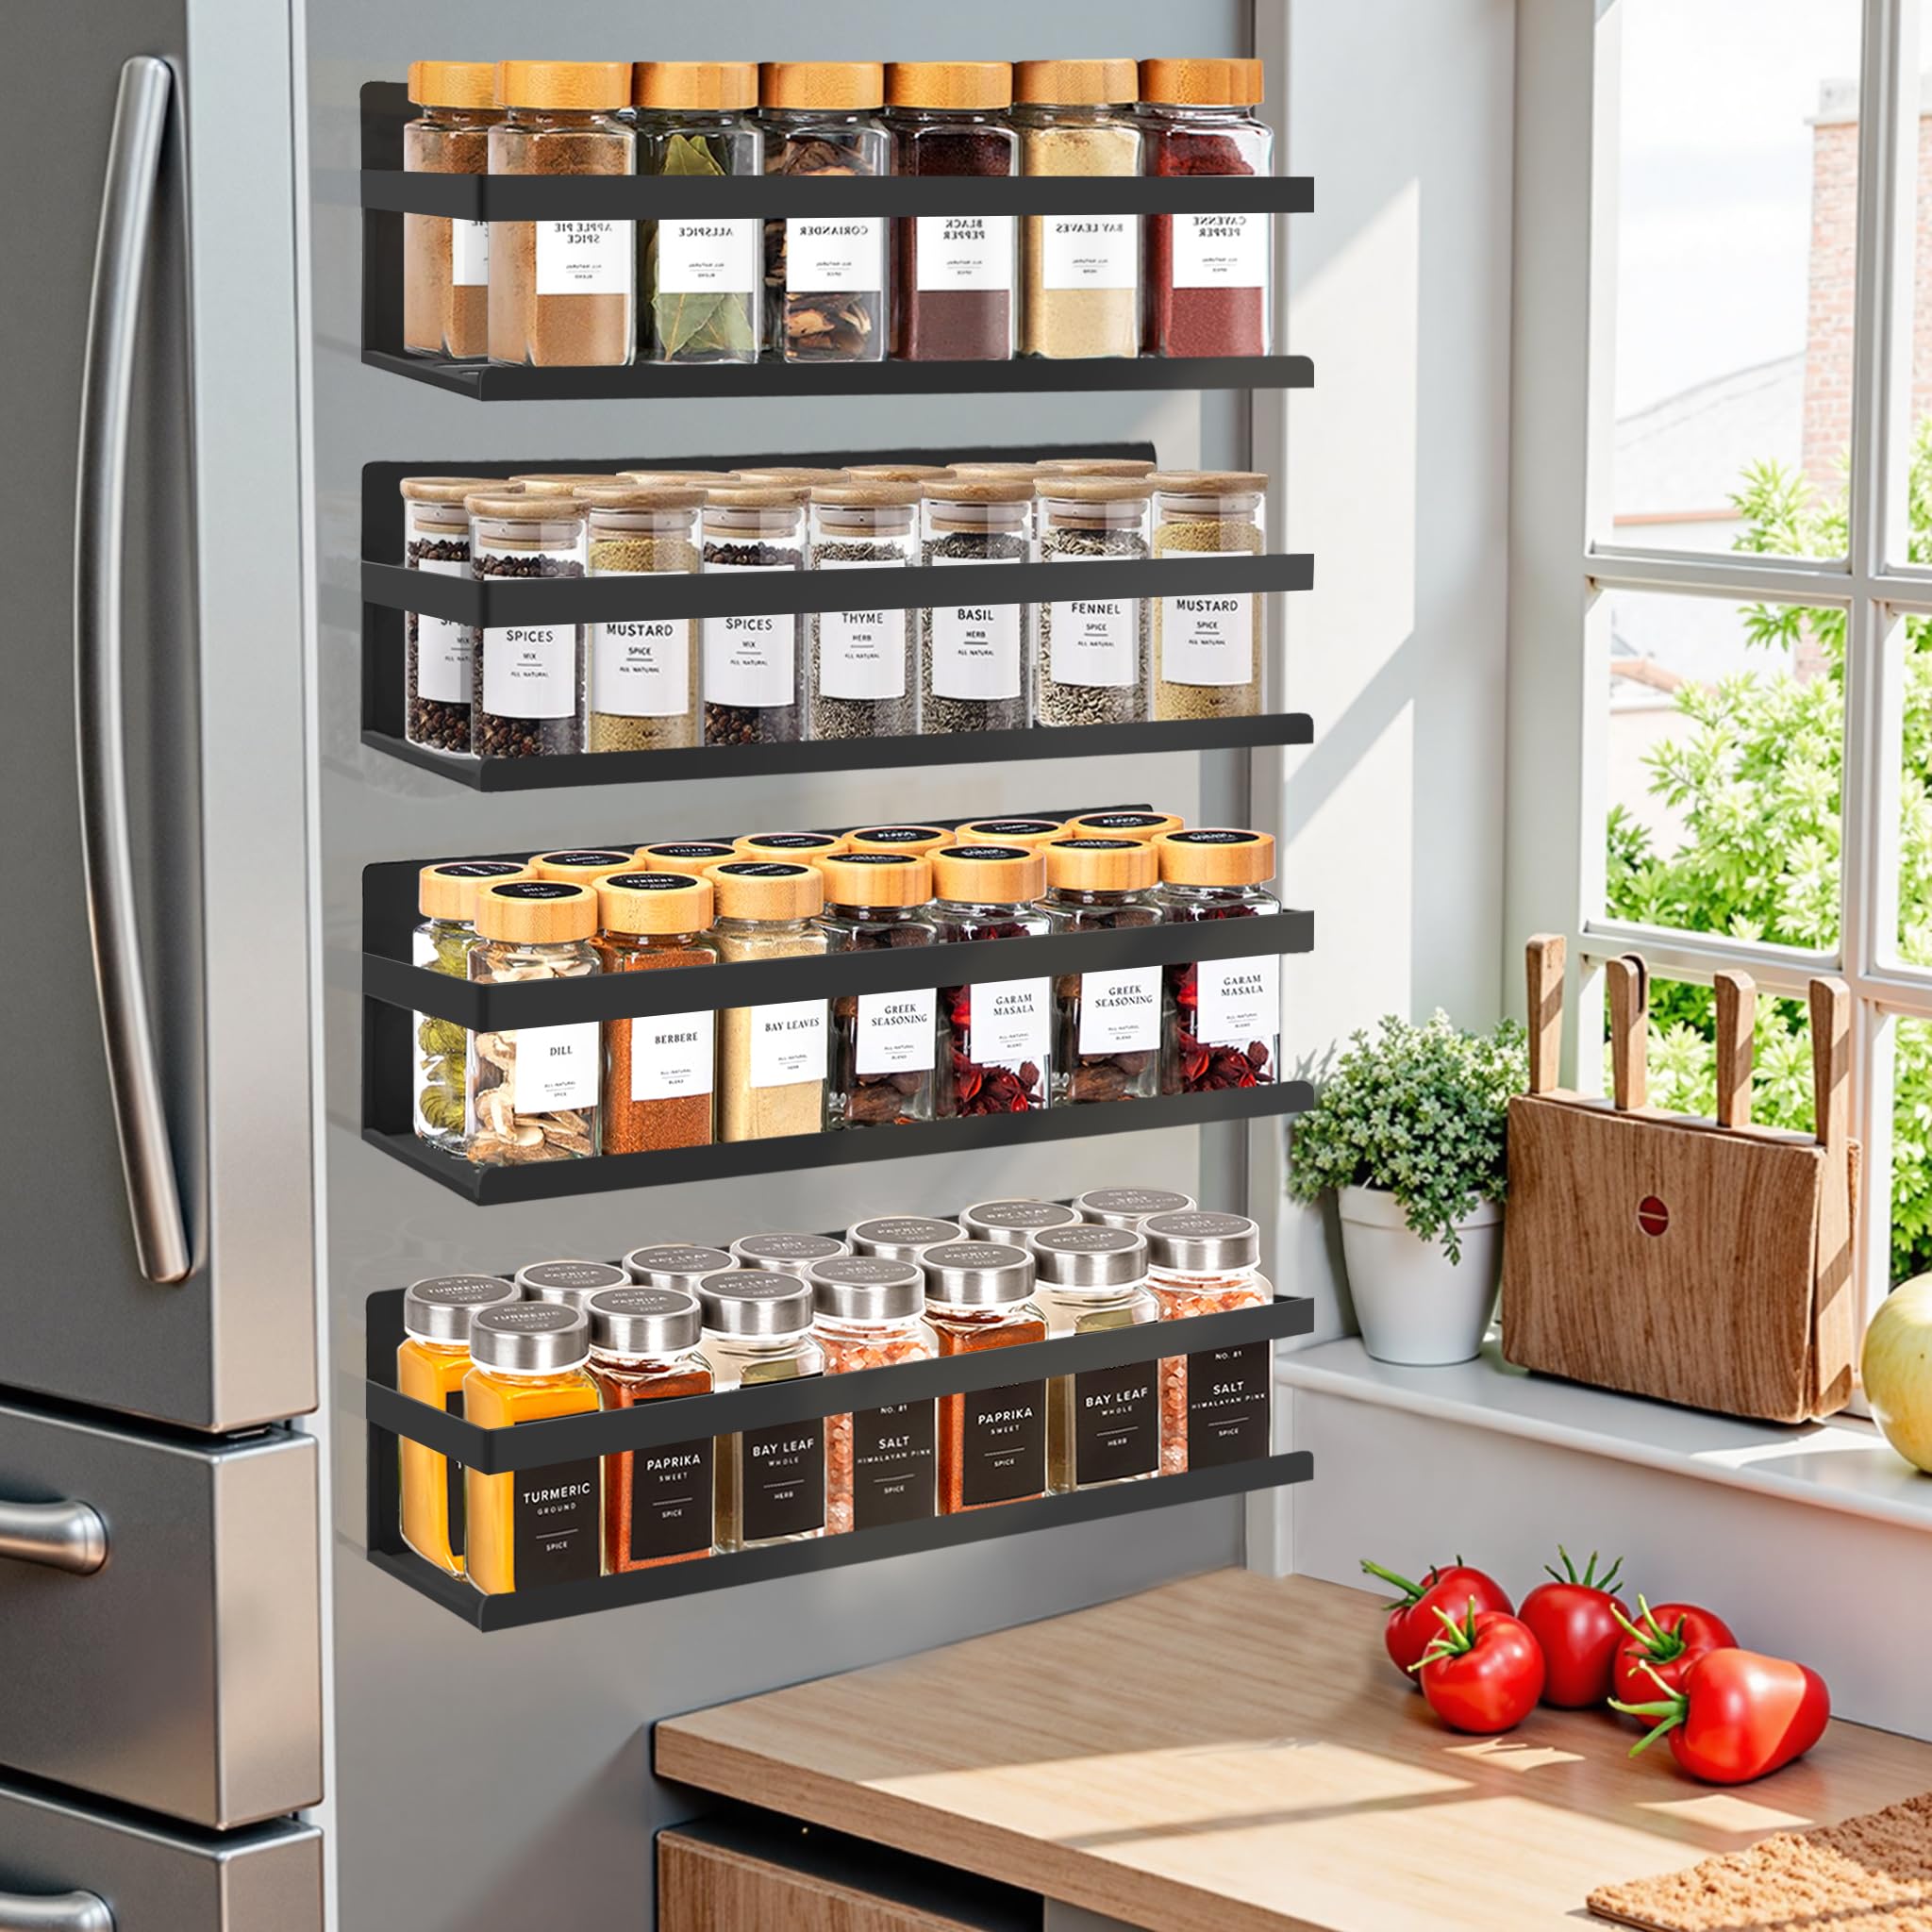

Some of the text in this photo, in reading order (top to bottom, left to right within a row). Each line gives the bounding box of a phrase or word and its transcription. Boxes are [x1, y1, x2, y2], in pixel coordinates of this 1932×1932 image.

[1071, 603, 1121, 614] FENNEL
[1176, 599, 1239, 611] MUSTARD
[841, 612, 884, 625] THYME
[958, 608, 994, 621] BASIL
[606, 623, 674, 637] MUSTARD
[725, 617, 774, 631] SPICES
[1086, 623, 1108, 631] SPICE
[1196, 621, 1218, 629] SPICE
[507, 629, 553, 642] SPICES
[966, 630, 986, 639] HERB
[627, 646, 652, 656] SPICE
[1223, 974, 1261, 986] GARAM
[1108, 985, 1142, 996] GREEK
[1221, 985, 1264, 996] MASALA
[995, 993, 1033, 1005] GARAM
[1094, 994, 1153, 1008] SEASONING
[884, 1003, 917, 1014] GREEK
[993, 1004, 1035, 1016] MASALA
[765, 1017, 820, 1033] BAY LEAVES
[871, 1013, 927, 1026] SEASONING
[655, 1031, 698, 1044] BERBERE
[549, 1045, 573, 1057] DILL
[1212, 1380, 1244, 1395] SALT
[1085, 1387, 1148, 1407] BAY LEAF
[1191, 1397, 1241, 1408] HIMALAYAN
[977, 1407, 1033, 1425] PAPRIKA
[991, 1424, 1020, 1435] SWEET
[1218, 1427, 1239, 1437] SPICE
[752, 1438, 815, 1457] BAY LEAF
[878, 1435, 910, 1450] SALT
[1108, 1438, 1127, 1447] HERB
[646, 1454, 701, 1471] PAPRIKA
[768, 1456, 800, 1466] WHOLE
[858, 1453, 908, 1463] HIMALAYAN
[994, 1457, 1015, 1467] SPICE
[659, 1472, 688, 1482] SWEET
[523, 1482, 591, 1505] TURMERIC
[774, 1491, 794, 1499] HERB
[884, 1485, 905, 1494] SPICE
[537, 1502, 576, 1516] GROUND
[661, 1509, 682, 1519] SPICE
[546, 1541, 568, 1552] SPICE
